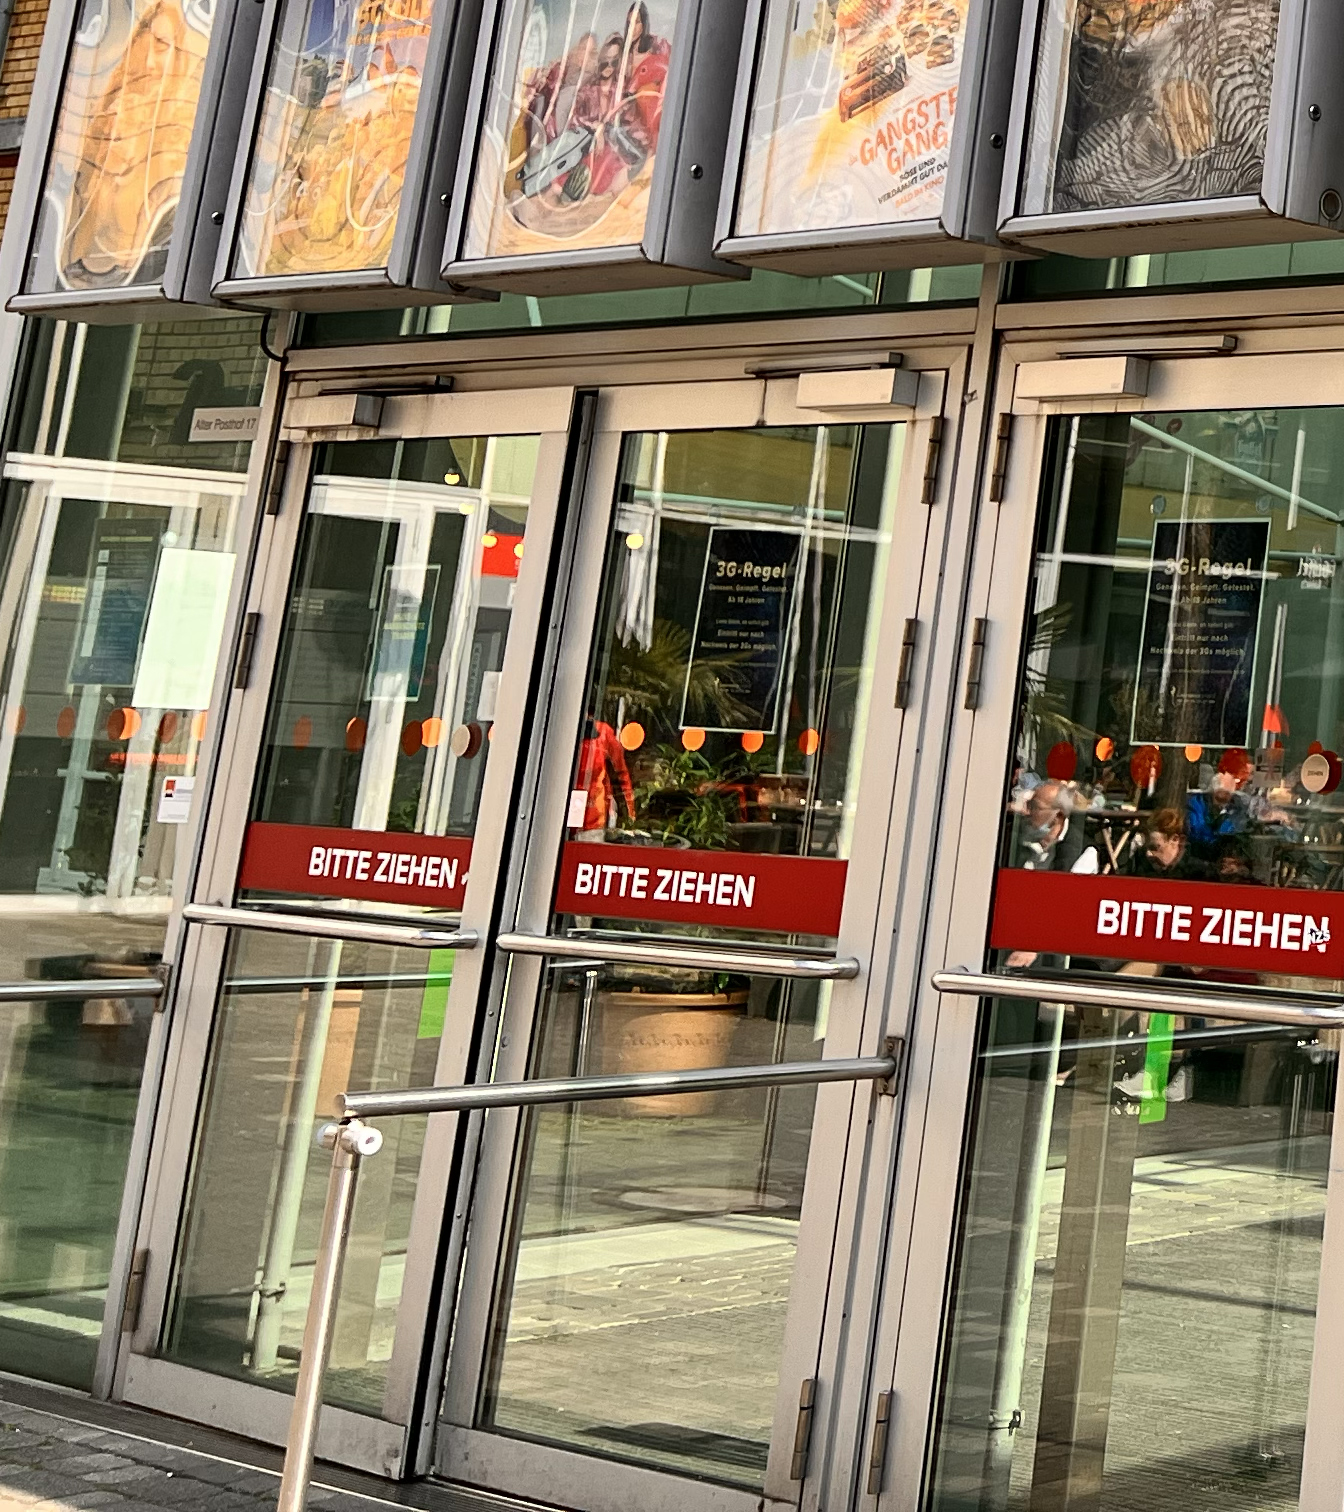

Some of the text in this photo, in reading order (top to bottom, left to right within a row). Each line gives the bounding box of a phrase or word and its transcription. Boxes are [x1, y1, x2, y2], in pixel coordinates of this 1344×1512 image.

[887, 120, 948, 175] GANG
[920, 166, 935, 181] GUT
[213, 417, 245, 431] Posthof
[246, 417, 257, 430] 17
[716, 560, 787, 582] 3G-Regel
[1164, 558, 1252, 580] 3G-Regel
[307, 845, 459, 889] BITTE ZIEHEN
[574, 862, 756, 908] BITTE ZIEHEN
[1096, 899, 1330, 954] BITTE ZIEHEN
